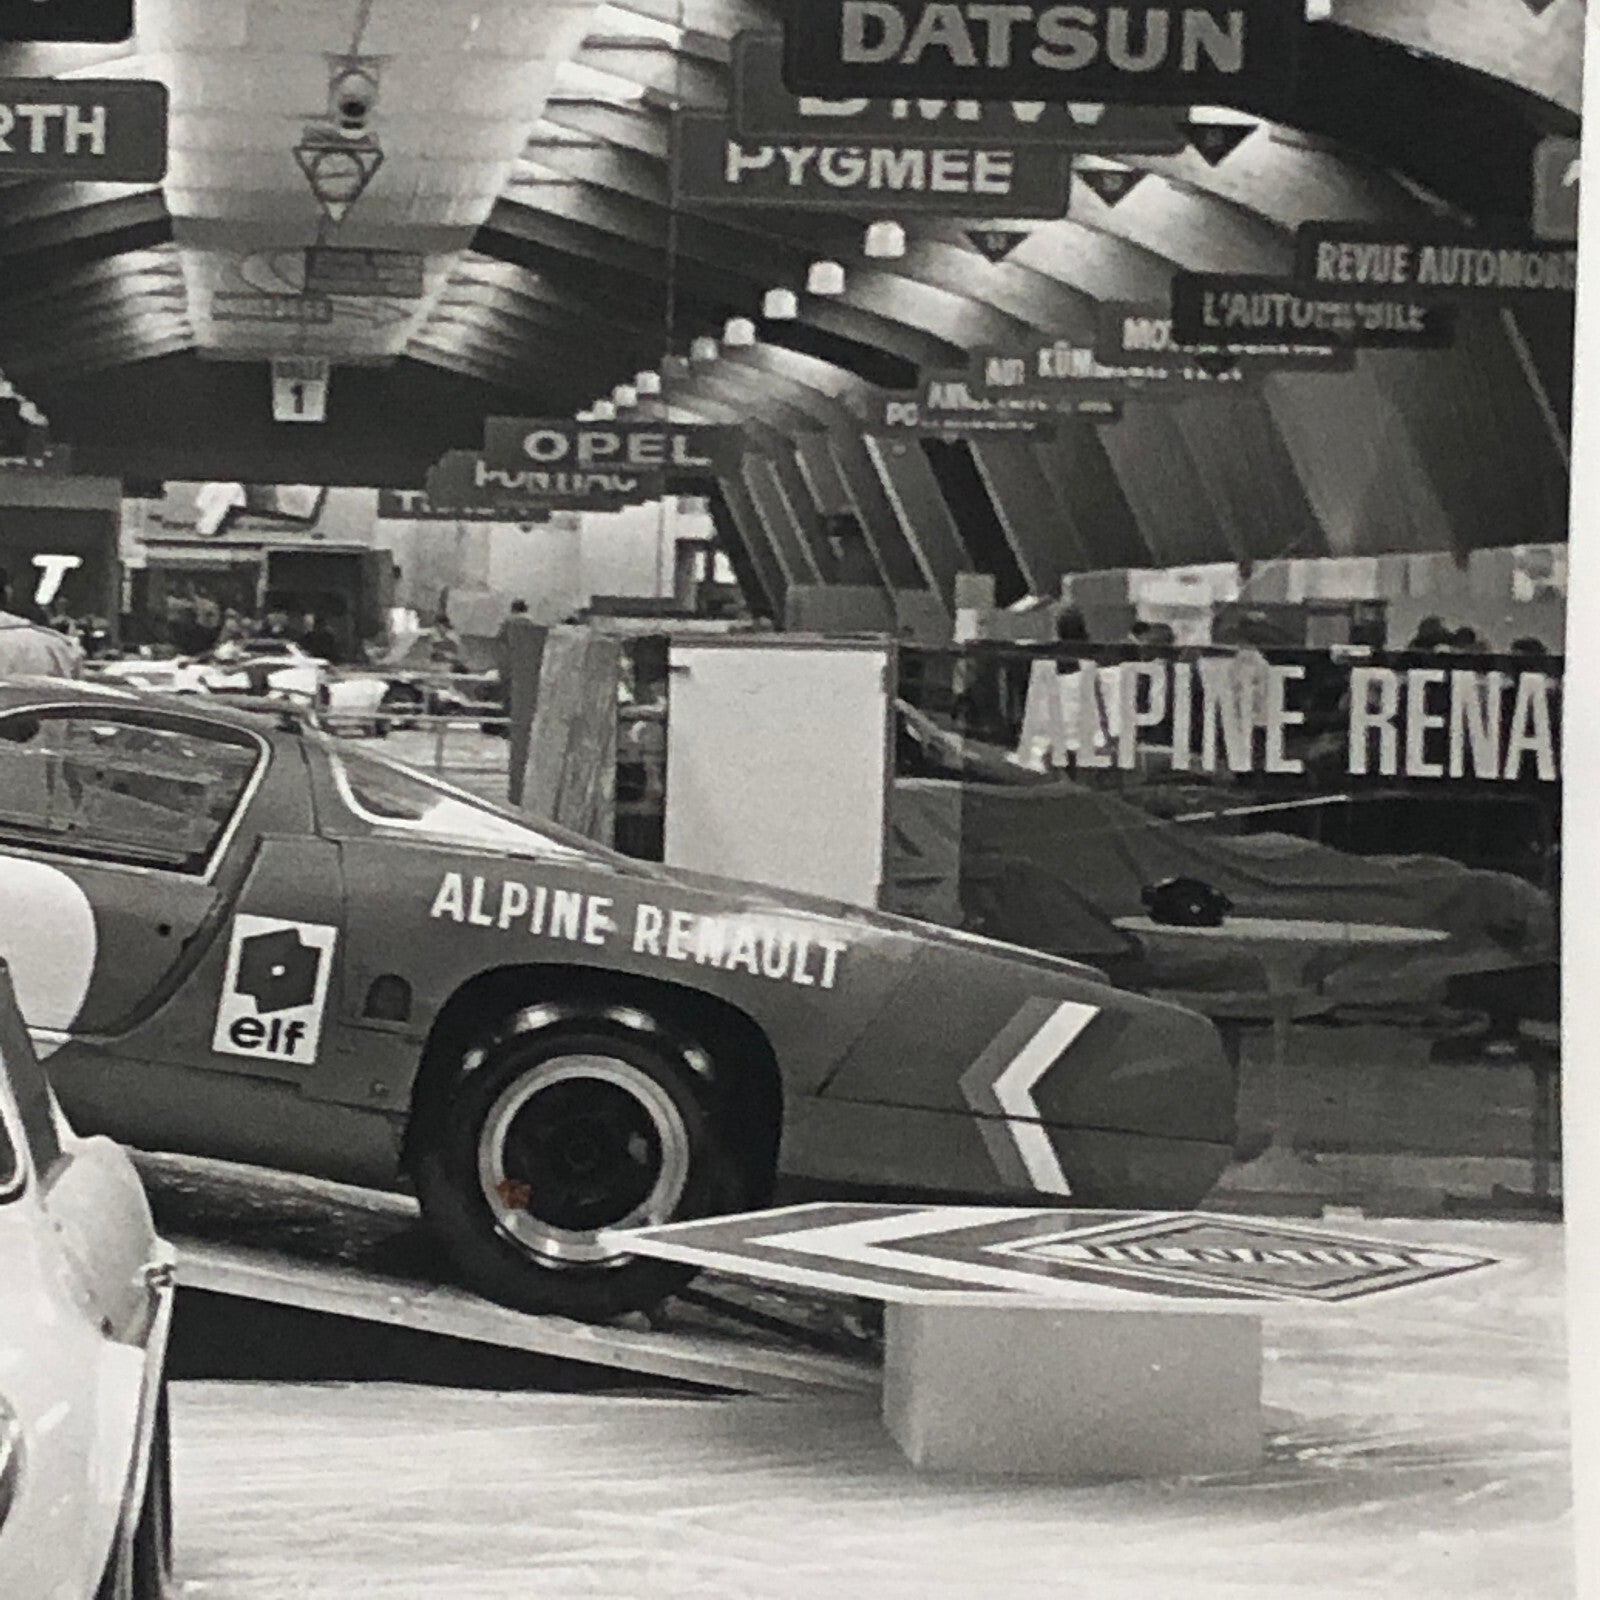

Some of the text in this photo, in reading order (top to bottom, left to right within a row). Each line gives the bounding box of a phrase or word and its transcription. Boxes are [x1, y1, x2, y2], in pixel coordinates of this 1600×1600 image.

[840, 1, 1245, 73] DATSUN
[725, 140, 1014, 194] PYGMEE
[1316, 241, 1409, 283] REVUE
[1203, 292, 1427, 331] L'AUTOILE
[523, 429, 712, 467] OPEL
[1016, 657, 1557, 781] ALPINE RENA
[430, 872, 847, 988] ALPINE RENAULT
[229, 1016, 307, 1056] elf
